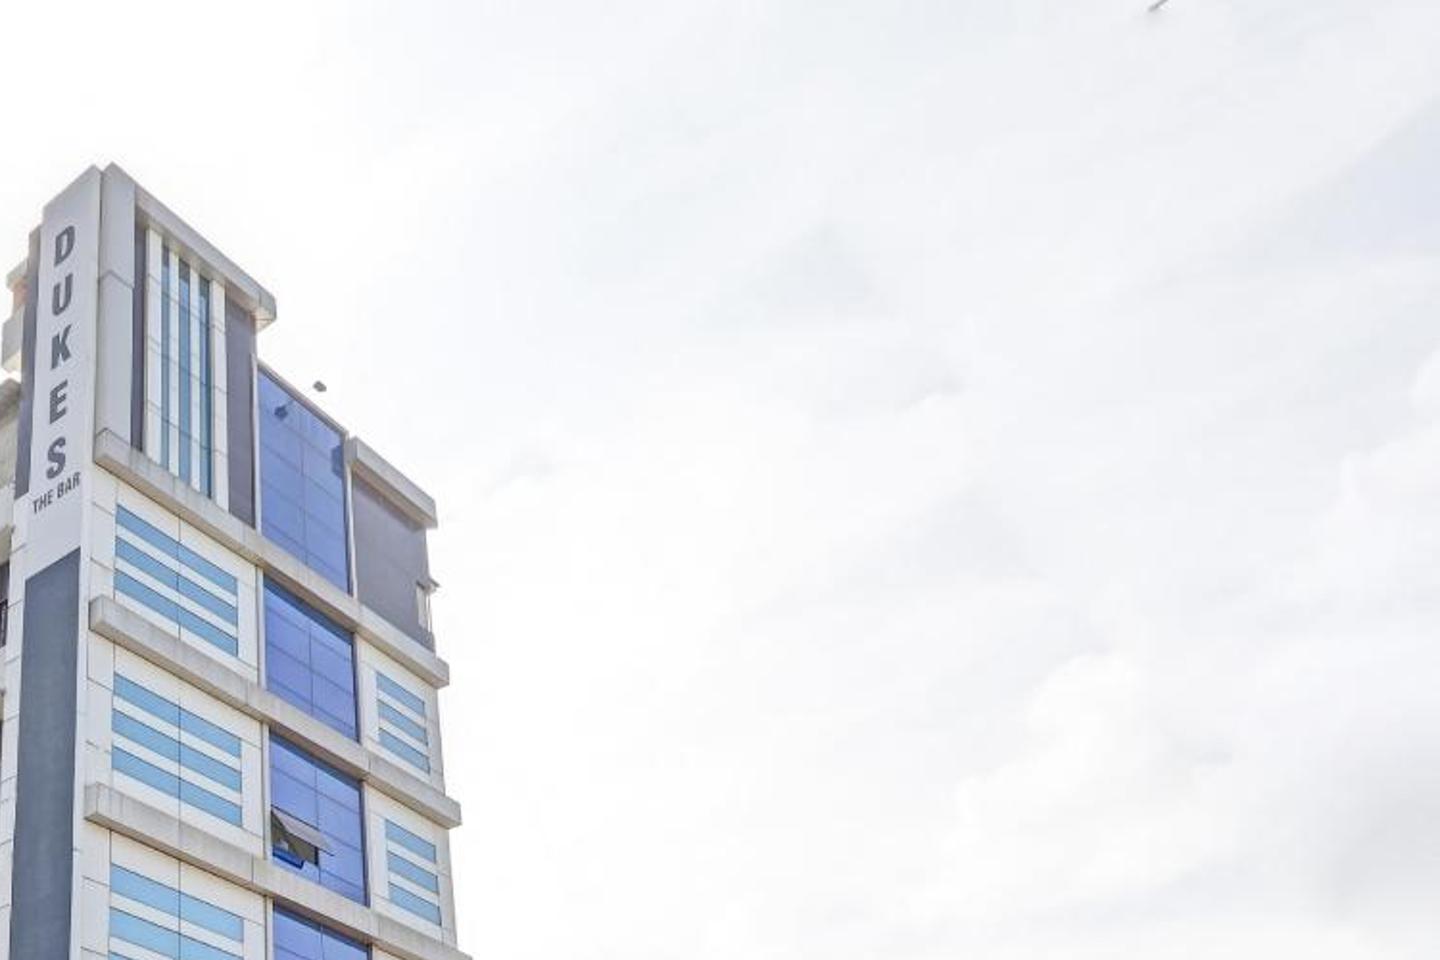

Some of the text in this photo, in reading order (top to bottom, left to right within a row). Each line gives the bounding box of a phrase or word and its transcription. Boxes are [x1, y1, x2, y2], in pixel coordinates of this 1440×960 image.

[46, 225, 76, 480] DUKES
[32, 471, 81, 515] THE BAR
